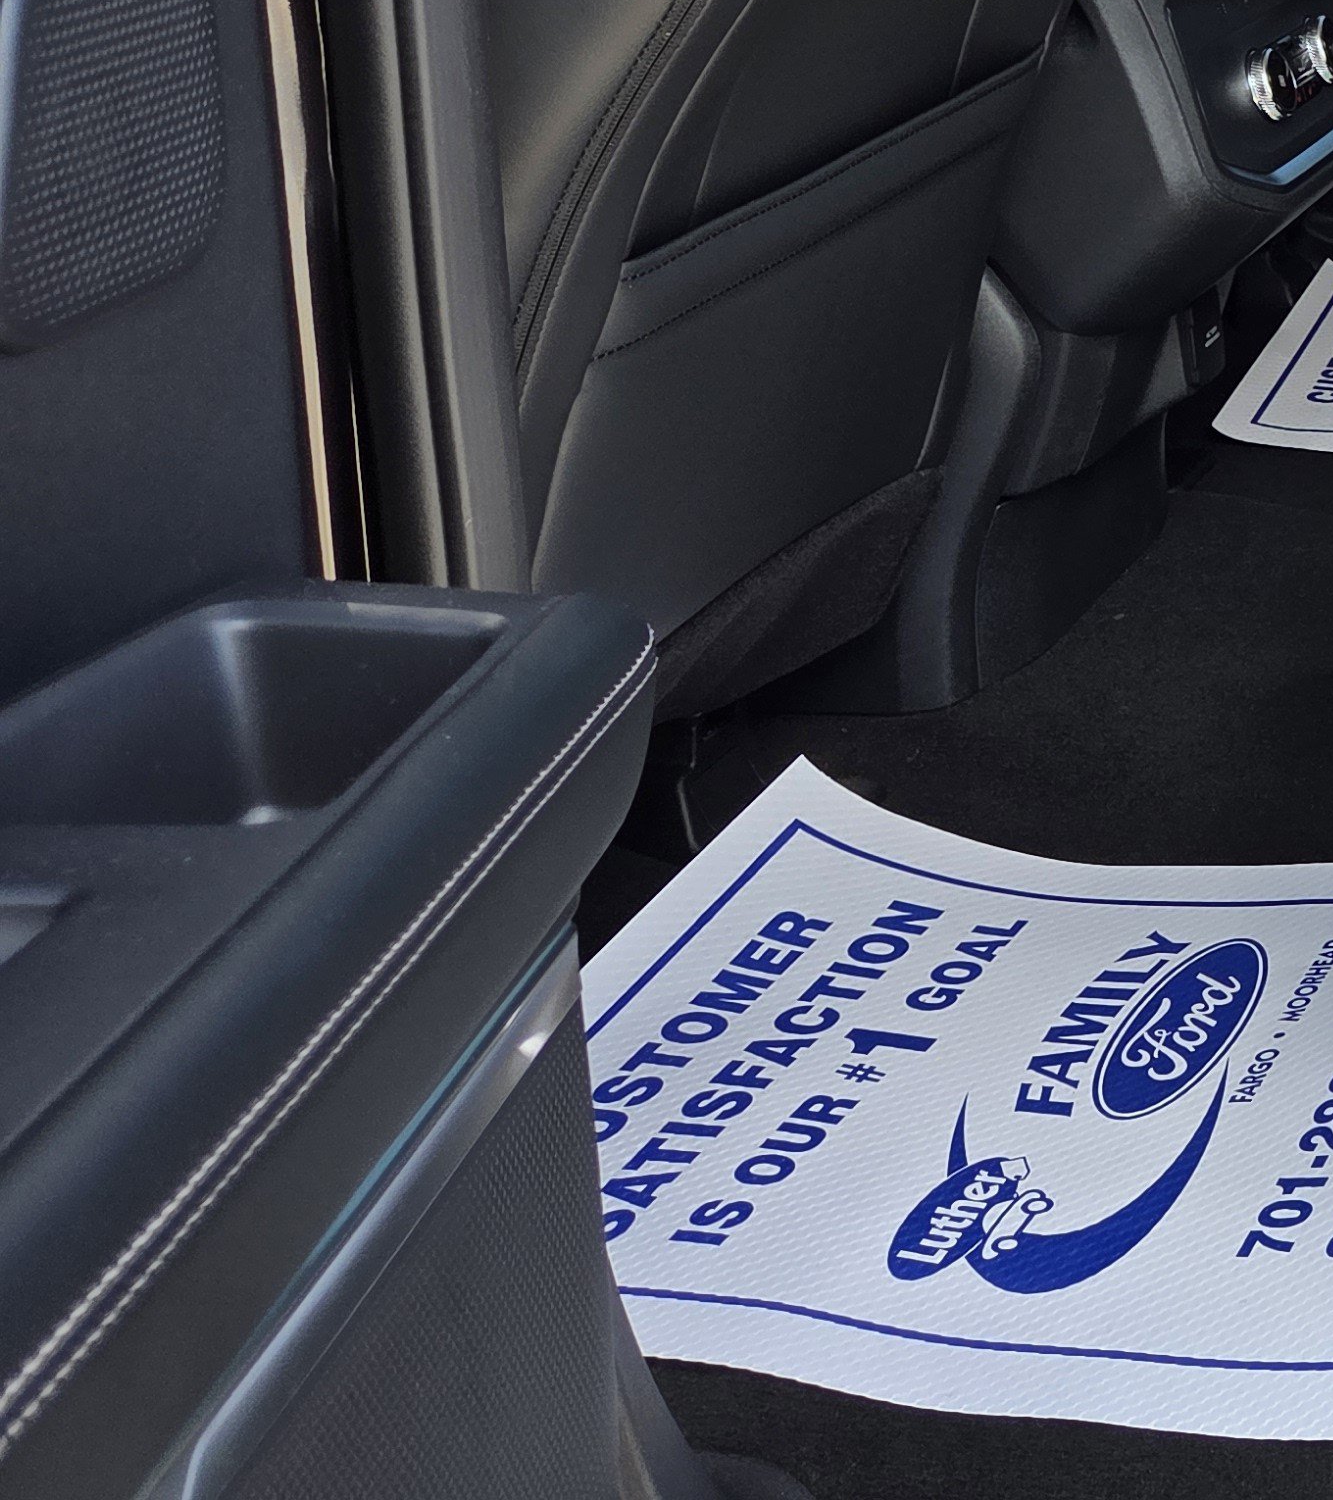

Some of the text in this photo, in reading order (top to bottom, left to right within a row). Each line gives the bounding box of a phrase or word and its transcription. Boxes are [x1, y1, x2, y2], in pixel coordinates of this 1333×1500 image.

[593, 911, 833, 1143] USTOMER
[668, 920, 1029, 1246] IS OUR #1 GOAL
[1014, 930, 1192, 1118] FAMILY
[1121, 972, 1242, 1080] Ford
[1229, 1049, 1280, 1103] FARGO
[897, 1169, 1010, 1264] Luther
